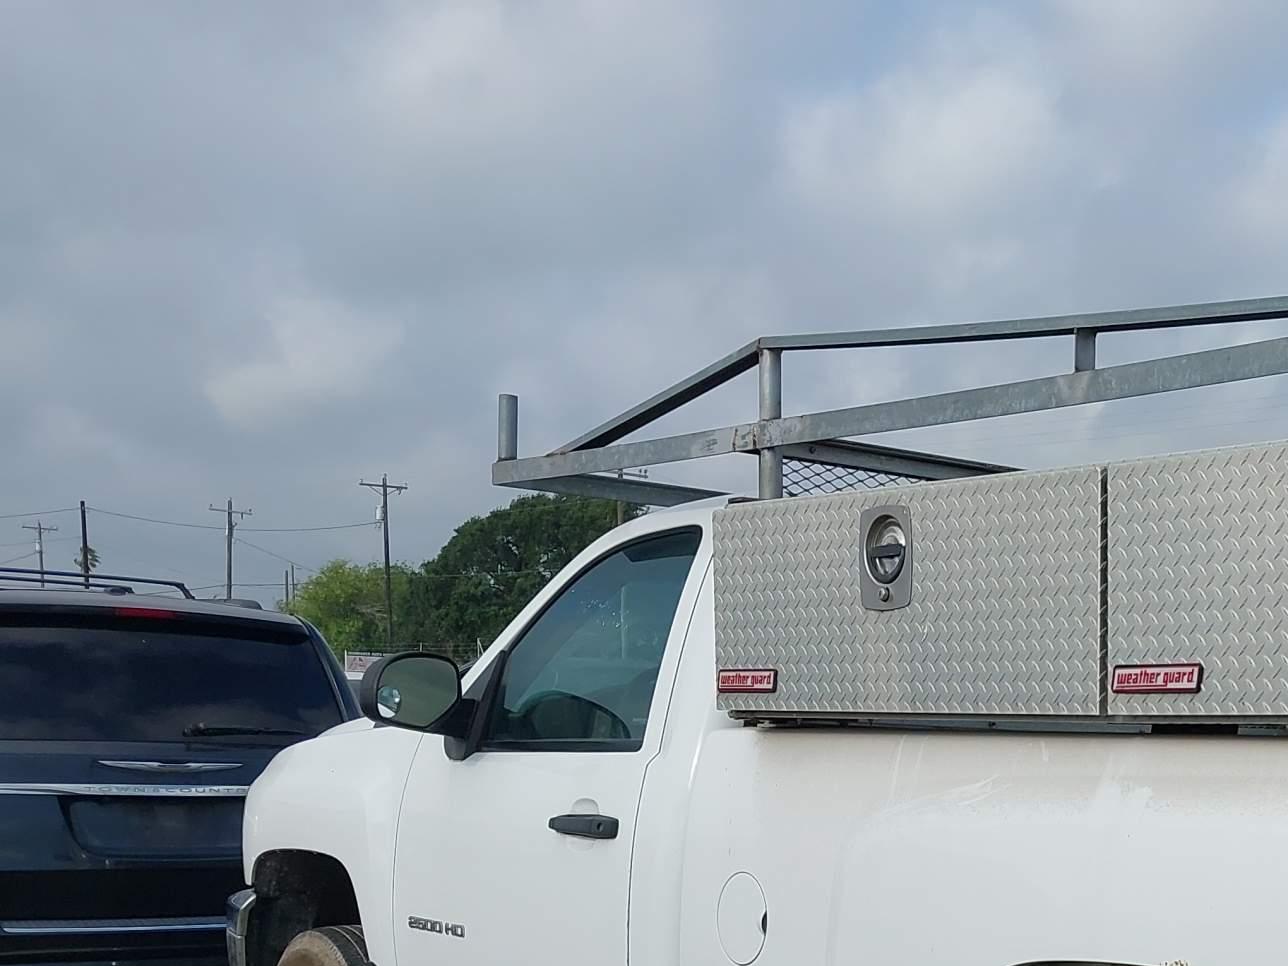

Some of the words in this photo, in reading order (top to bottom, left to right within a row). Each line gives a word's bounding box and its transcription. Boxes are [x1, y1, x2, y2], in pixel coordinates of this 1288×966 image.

[720, 672, 750, 685] weather
[751, 672, 772, 687] guard
[1117, 669, 1161, 684] weather
[1163, 668, 1195, 687] guard
[408, 915, 444, 934] 2500
[445, 922, 466, 938] HD
